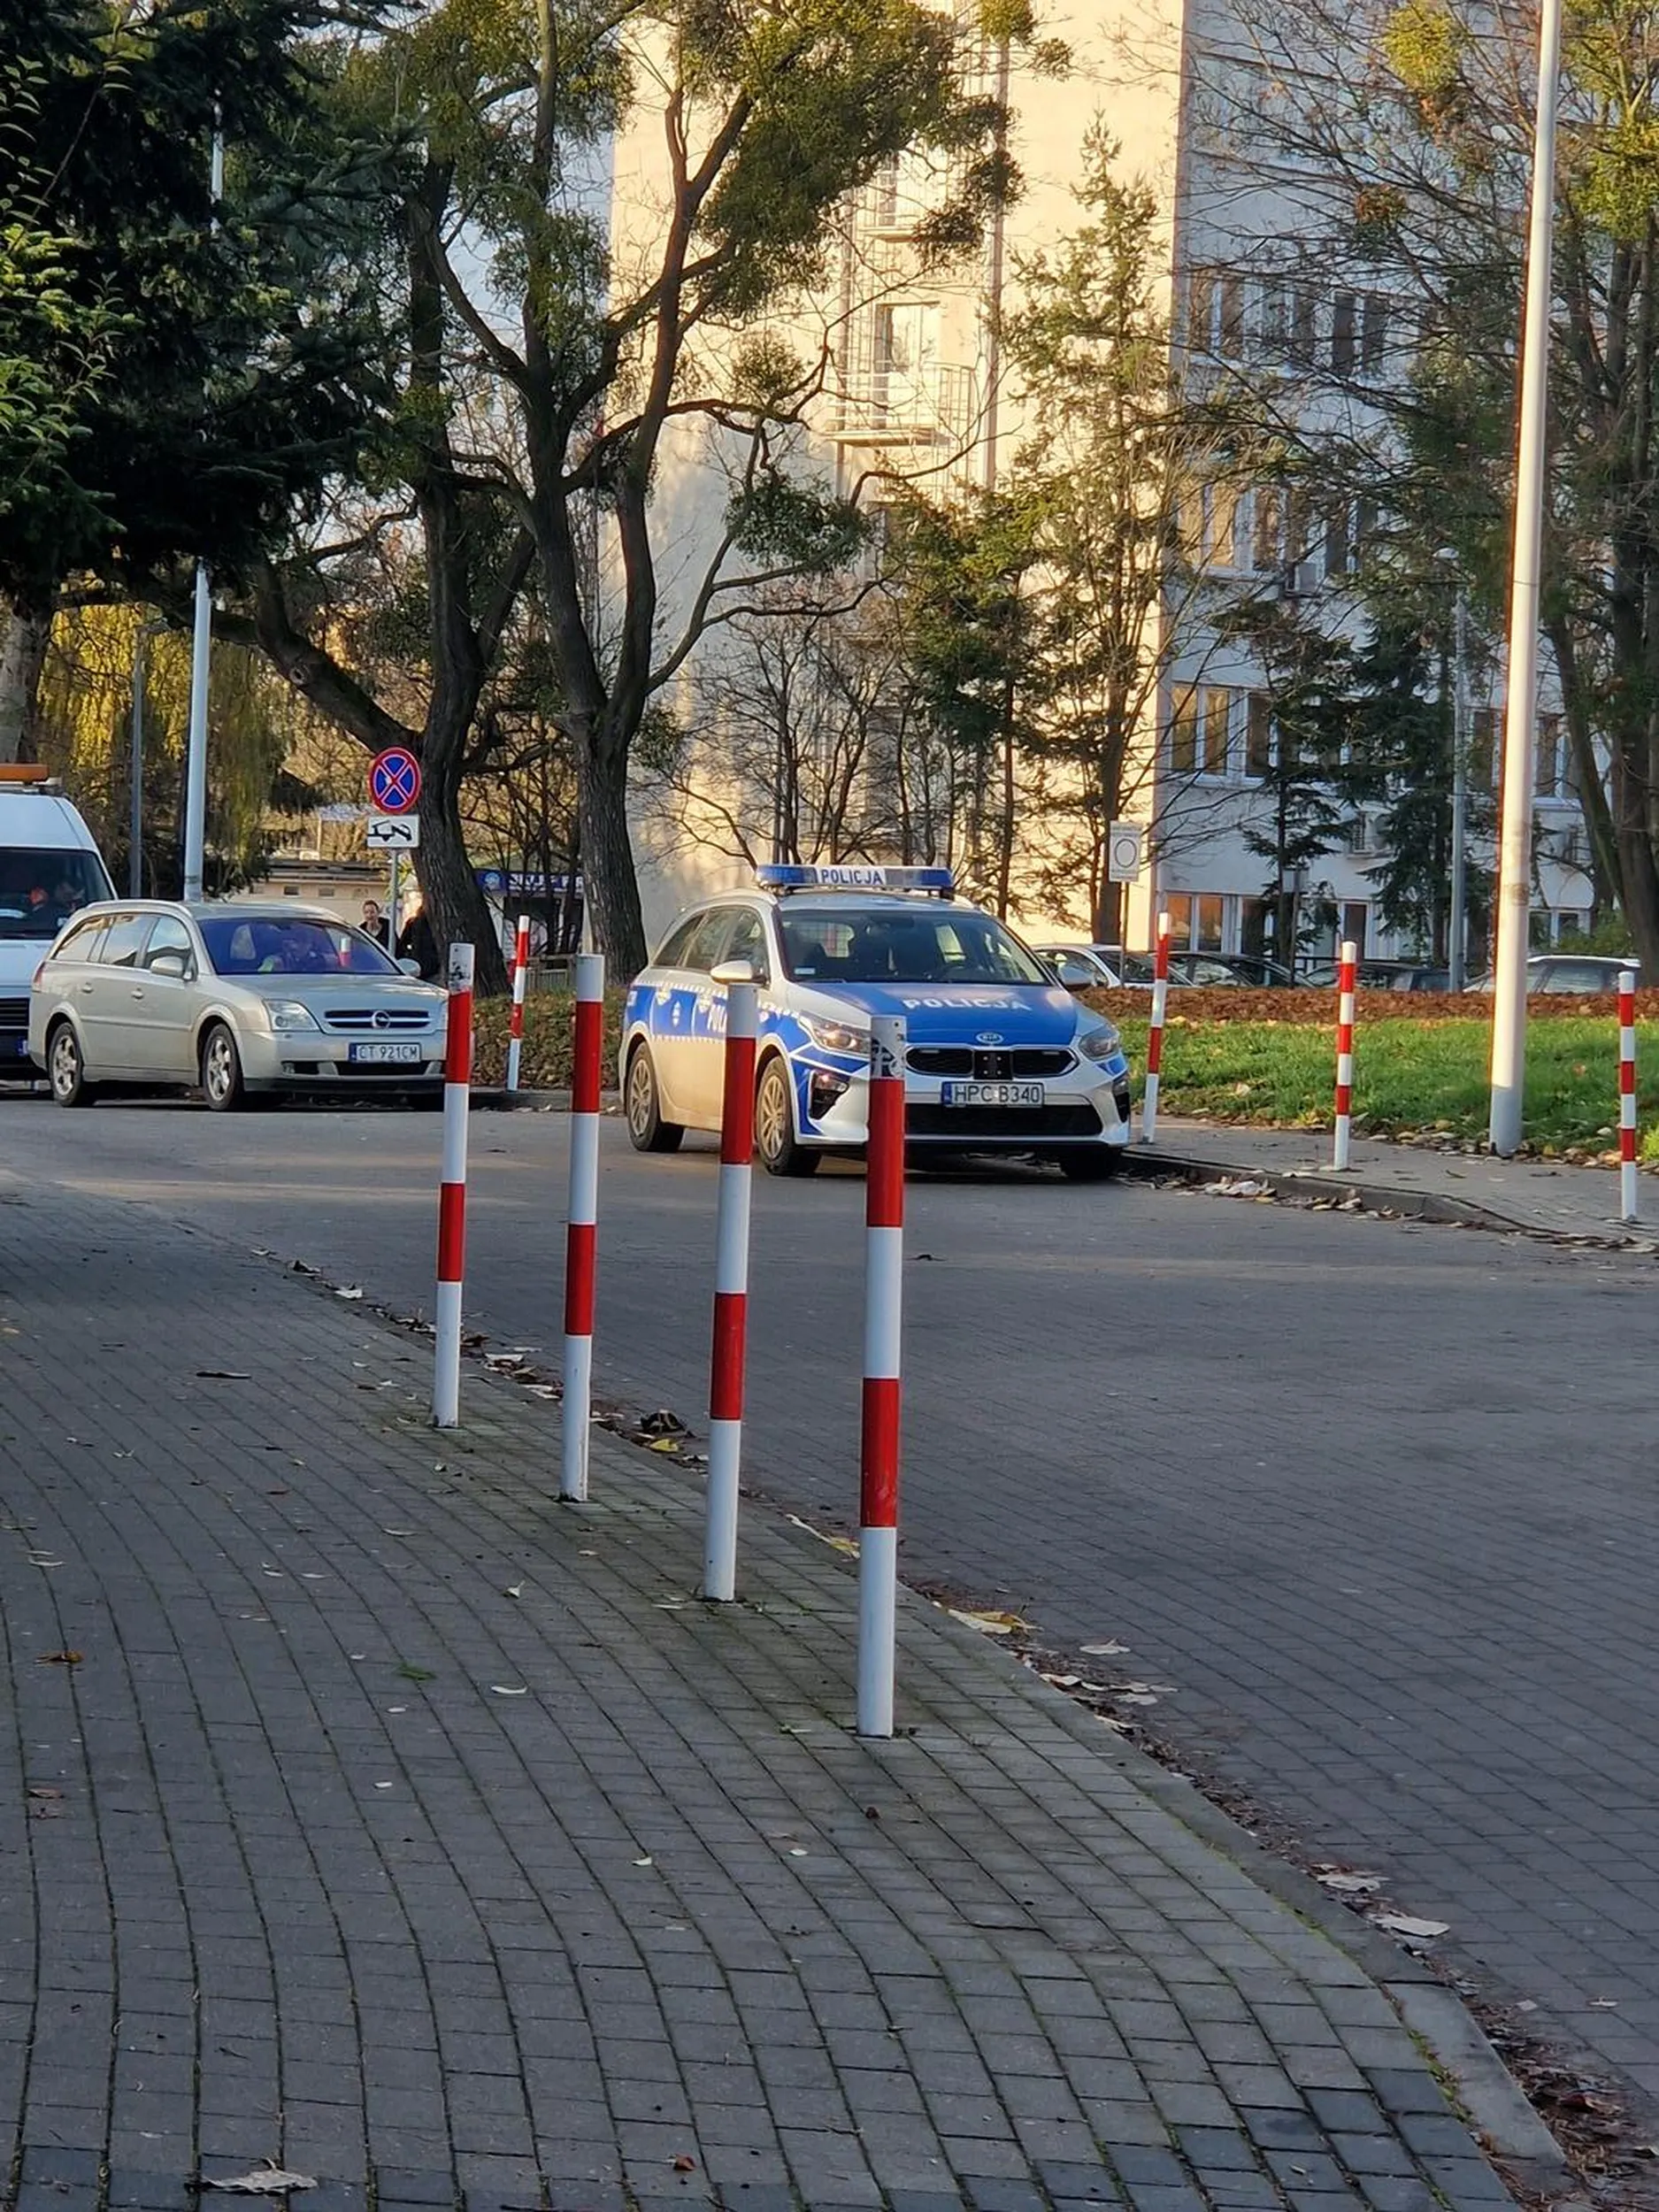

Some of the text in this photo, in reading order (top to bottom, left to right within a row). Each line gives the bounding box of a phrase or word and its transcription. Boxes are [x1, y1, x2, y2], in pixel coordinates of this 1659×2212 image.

[820, 869, 883, 885] POLICJA
[902, 998, 1033, 1010] POLICJA
[358, 1046, 375, 1059] CT
[955, 1086, 1040, 1103] HPC B340
